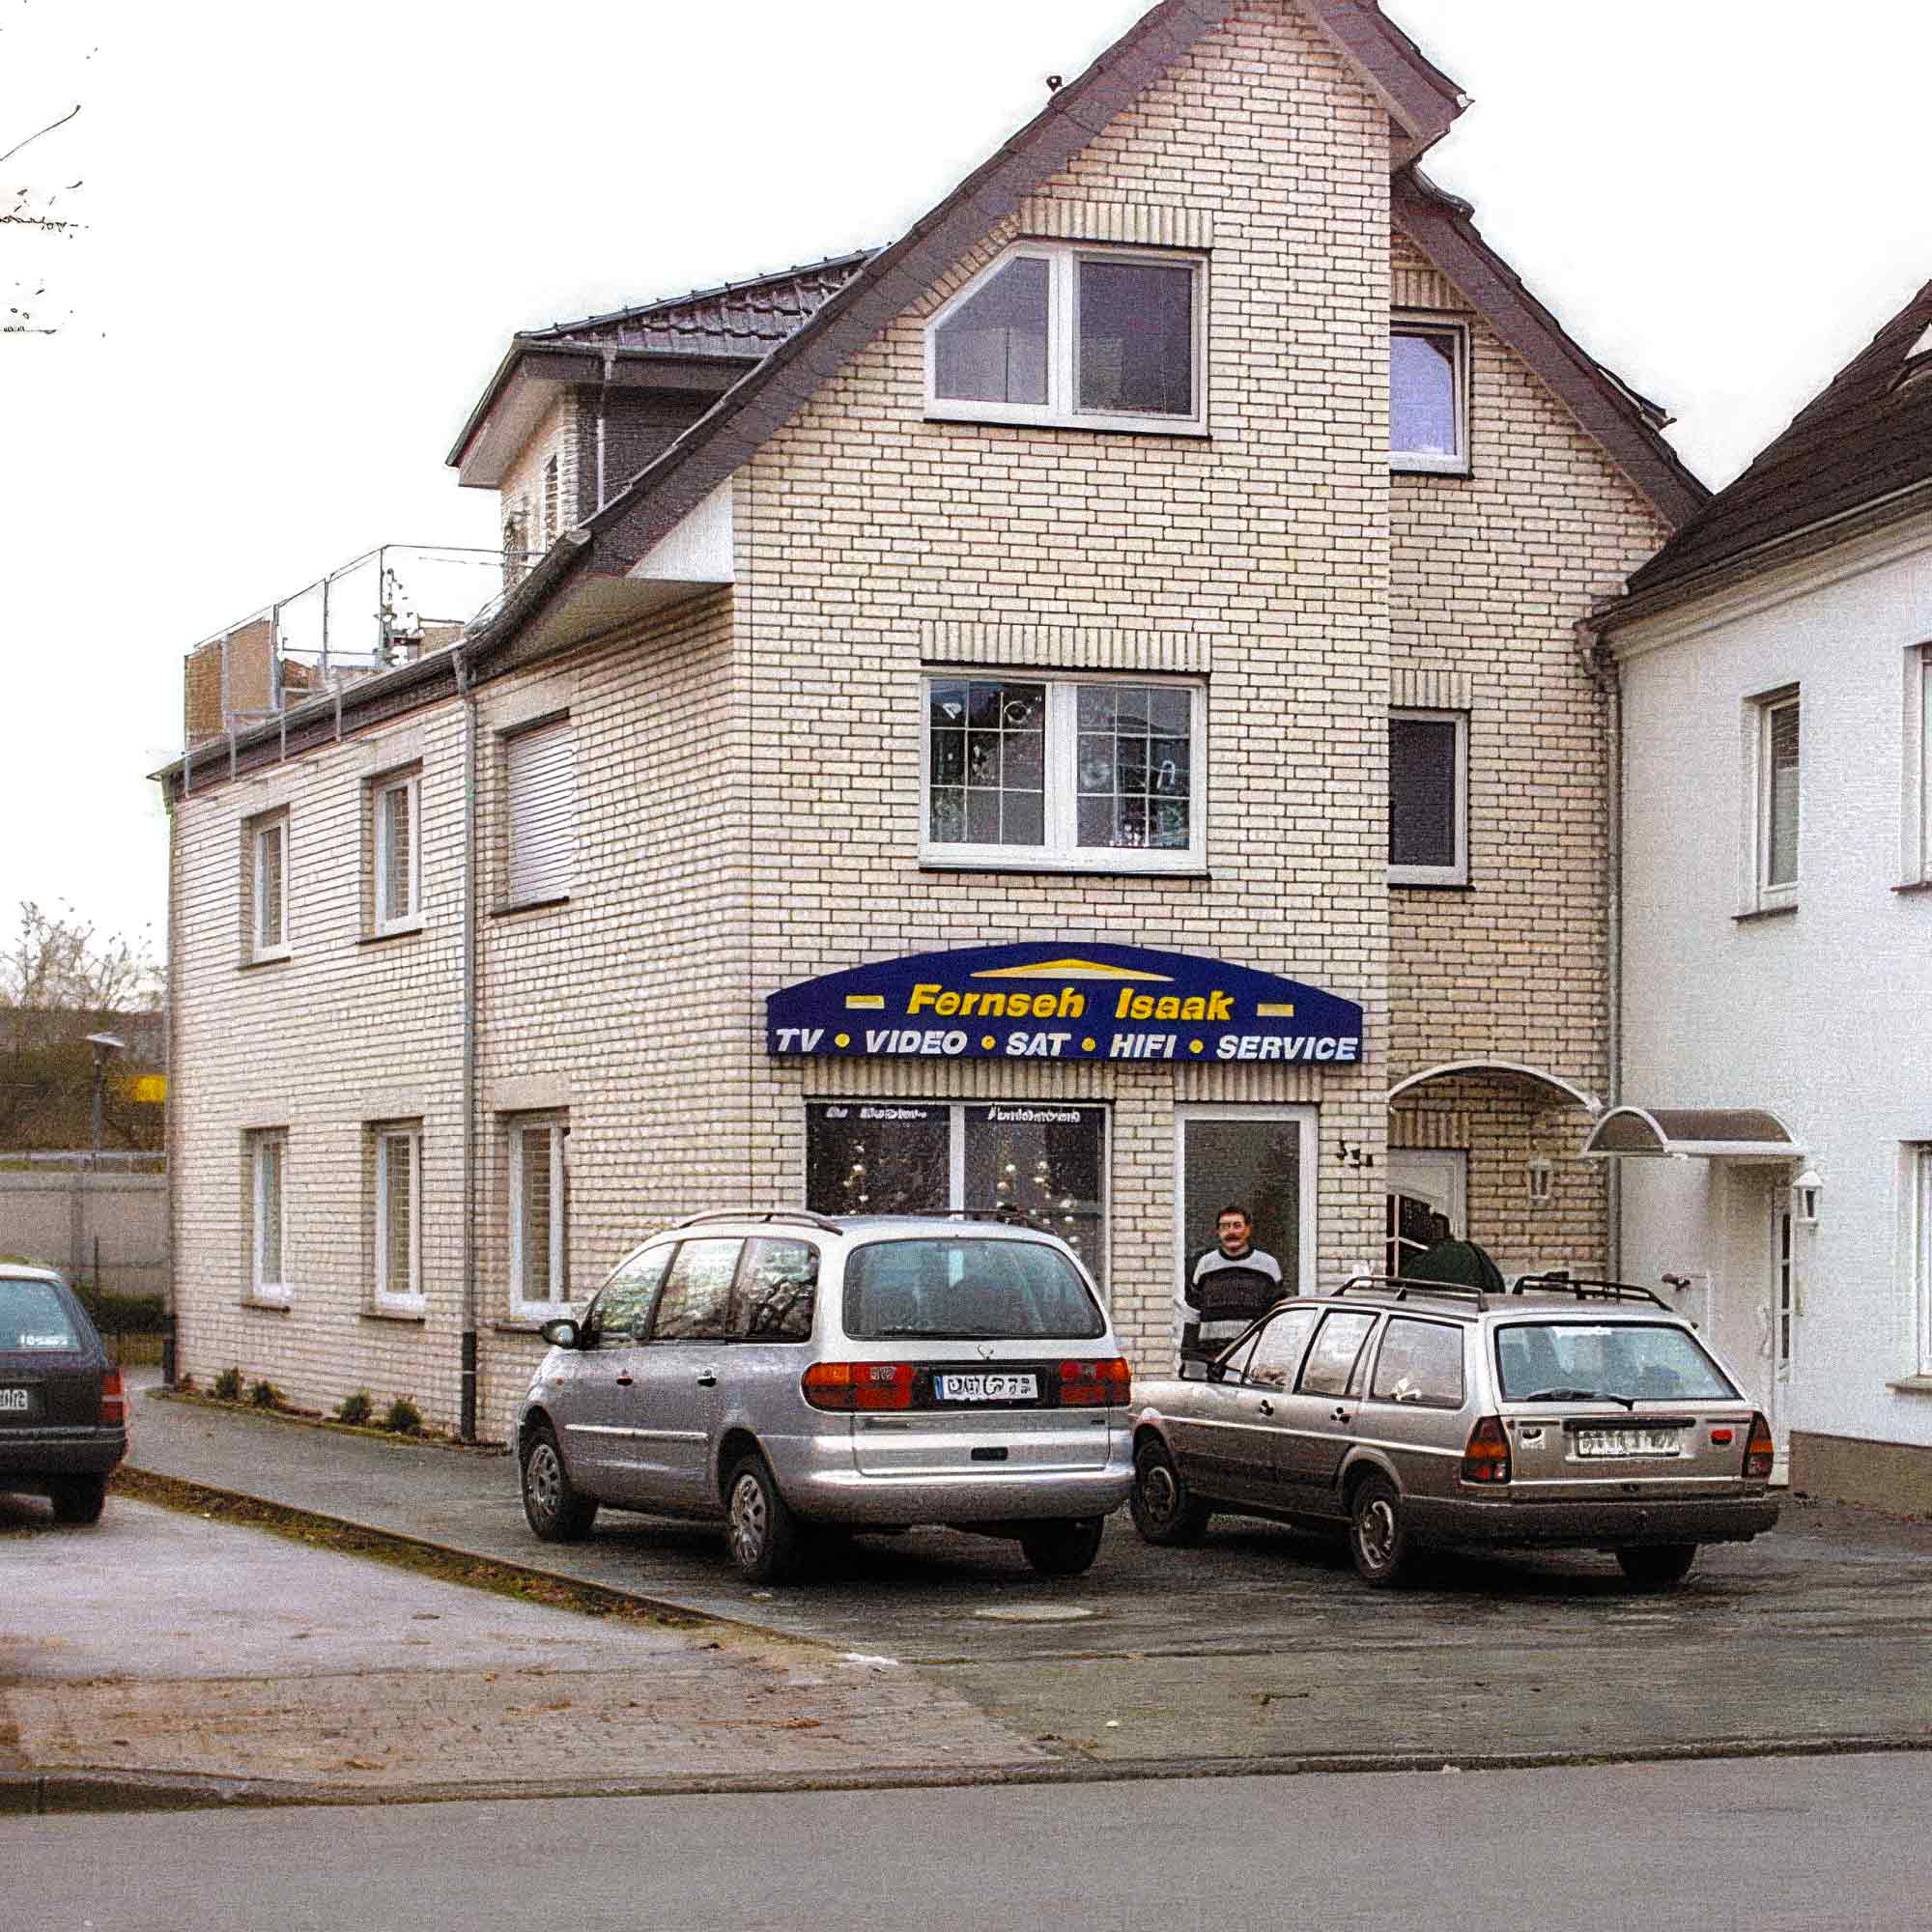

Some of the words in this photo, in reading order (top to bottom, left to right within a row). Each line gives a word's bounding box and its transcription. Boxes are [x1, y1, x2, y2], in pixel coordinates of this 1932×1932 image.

[908, 984, 1084, 1017] Fernseh
[1116, 988, 1233, 1020] Isaak
[777, 1029, 824, 1051] TV
[867, 1030, 967, 1054] VIDEO
[1007, 1032, 1071, 1056] SAT
[1110, 1034, 1177, 1058] HIFI
[1216, 1036, 1358, 1060] SERVICE
